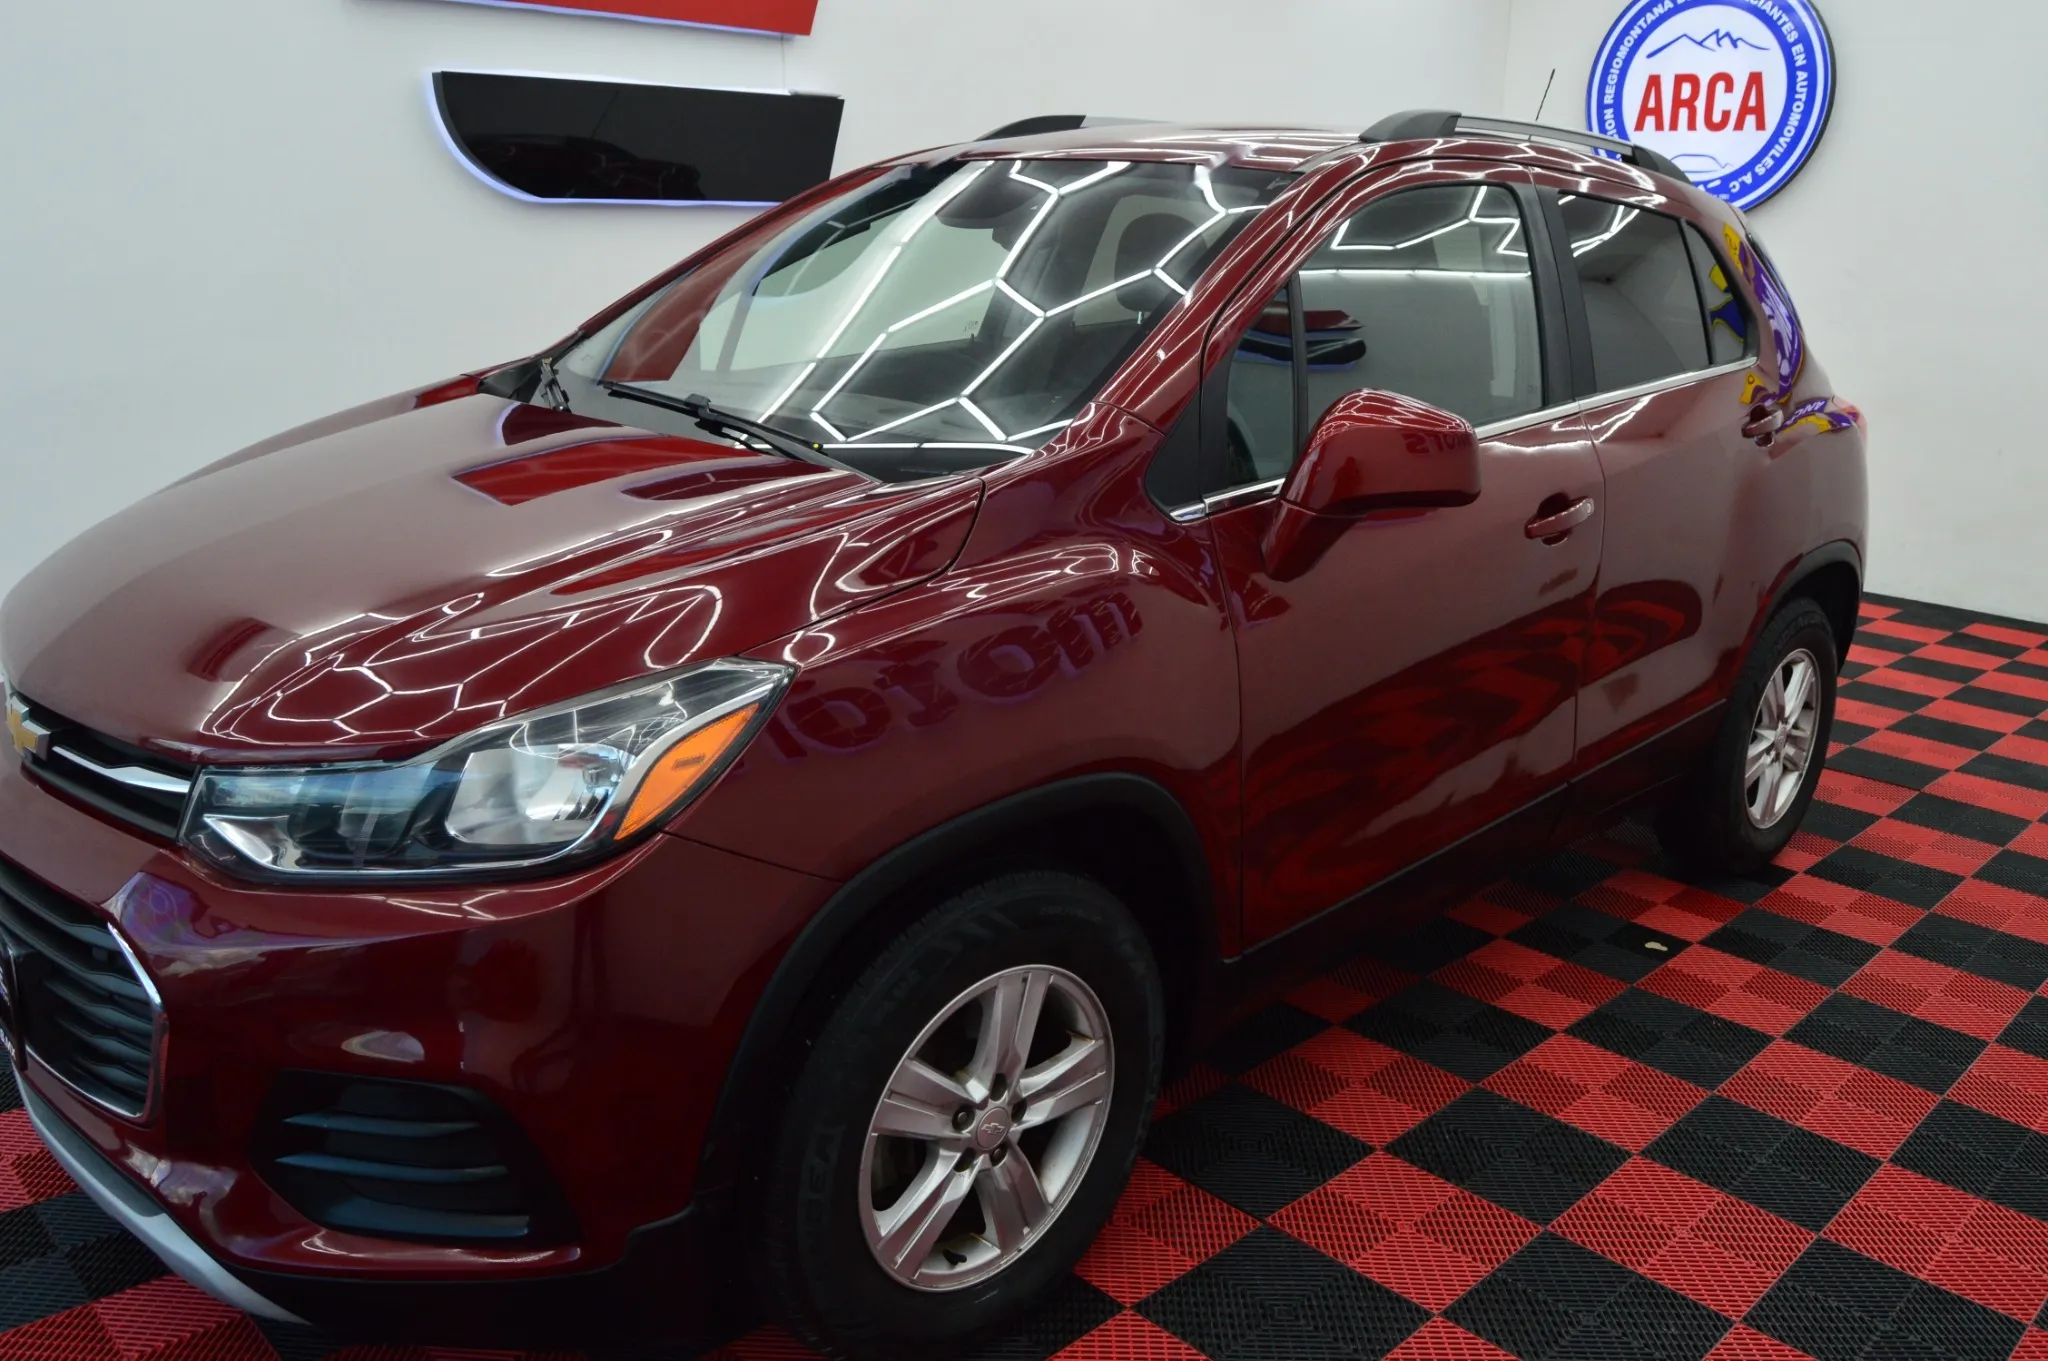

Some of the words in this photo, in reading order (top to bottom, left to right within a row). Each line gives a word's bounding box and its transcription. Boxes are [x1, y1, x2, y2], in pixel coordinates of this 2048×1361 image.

[1603, 0, 1674, 105] REGIOMONTANA
[1791, 43, 1807, 67] EN
[1634, 71, 1766, 132] ARCA
[1754, 70, 1808, 176] AUTOMOVILES
